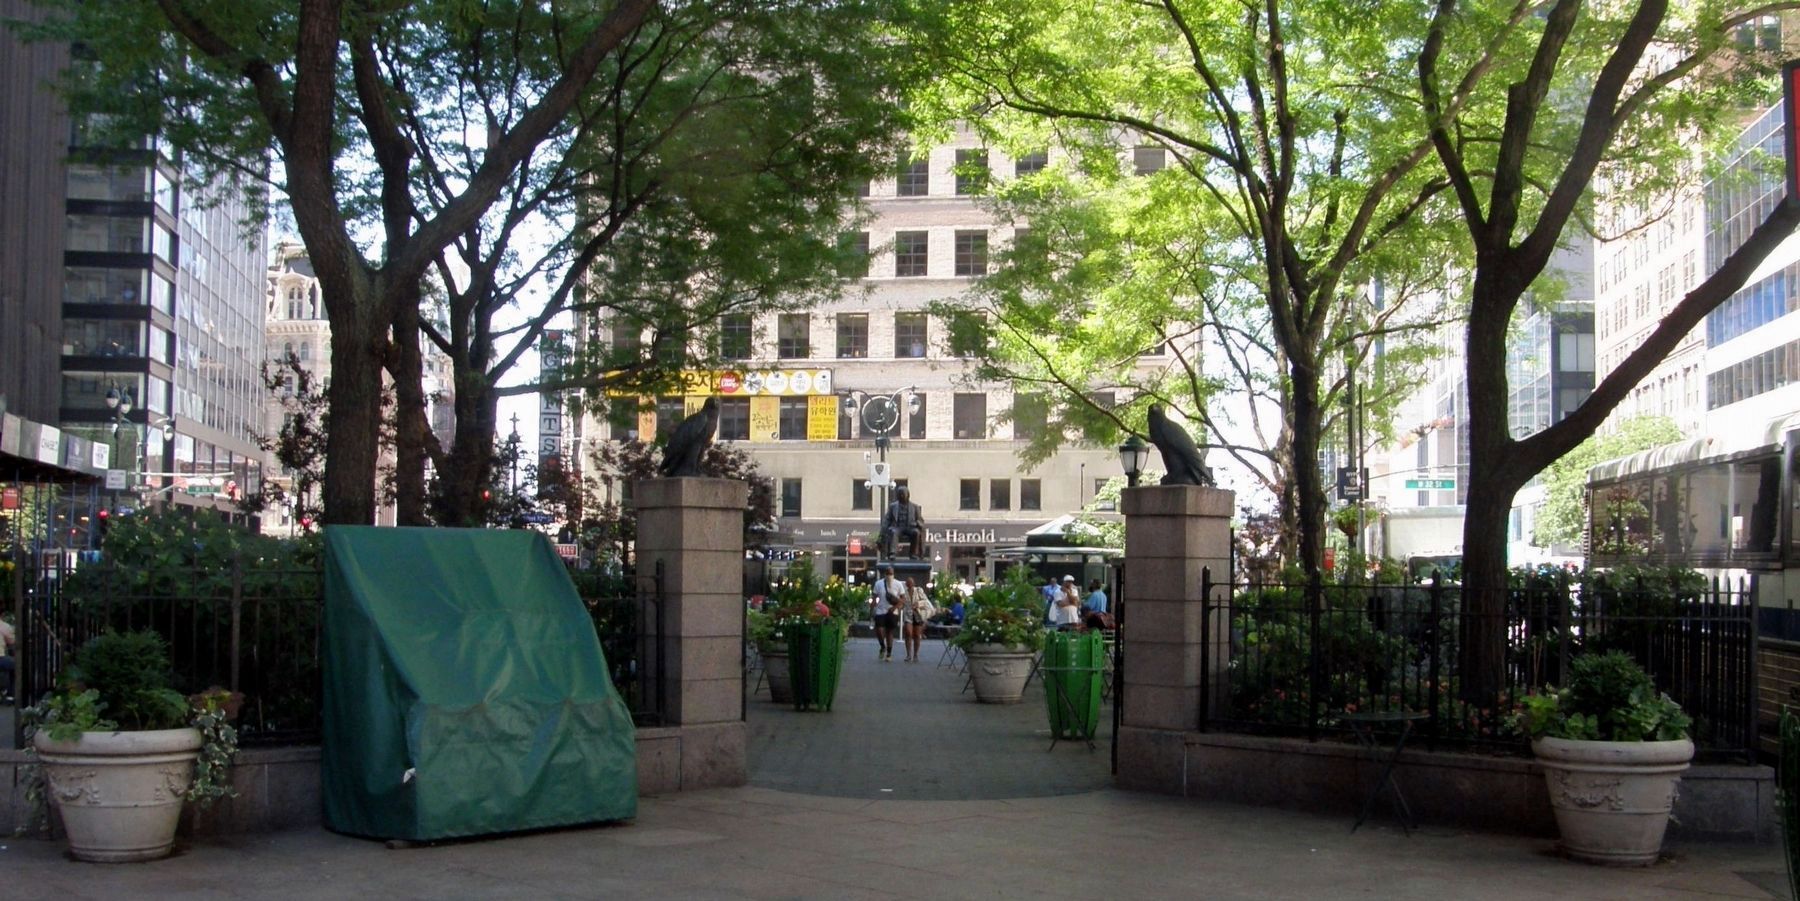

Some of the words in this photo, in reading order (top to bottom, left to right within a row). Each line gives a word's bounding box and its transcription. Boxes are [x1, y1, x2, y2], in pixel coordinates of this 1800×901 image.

[820, 529, 837, 537] lunch
[925, 528, 942, 543] he
[945, 528, 996, 543] Harold
